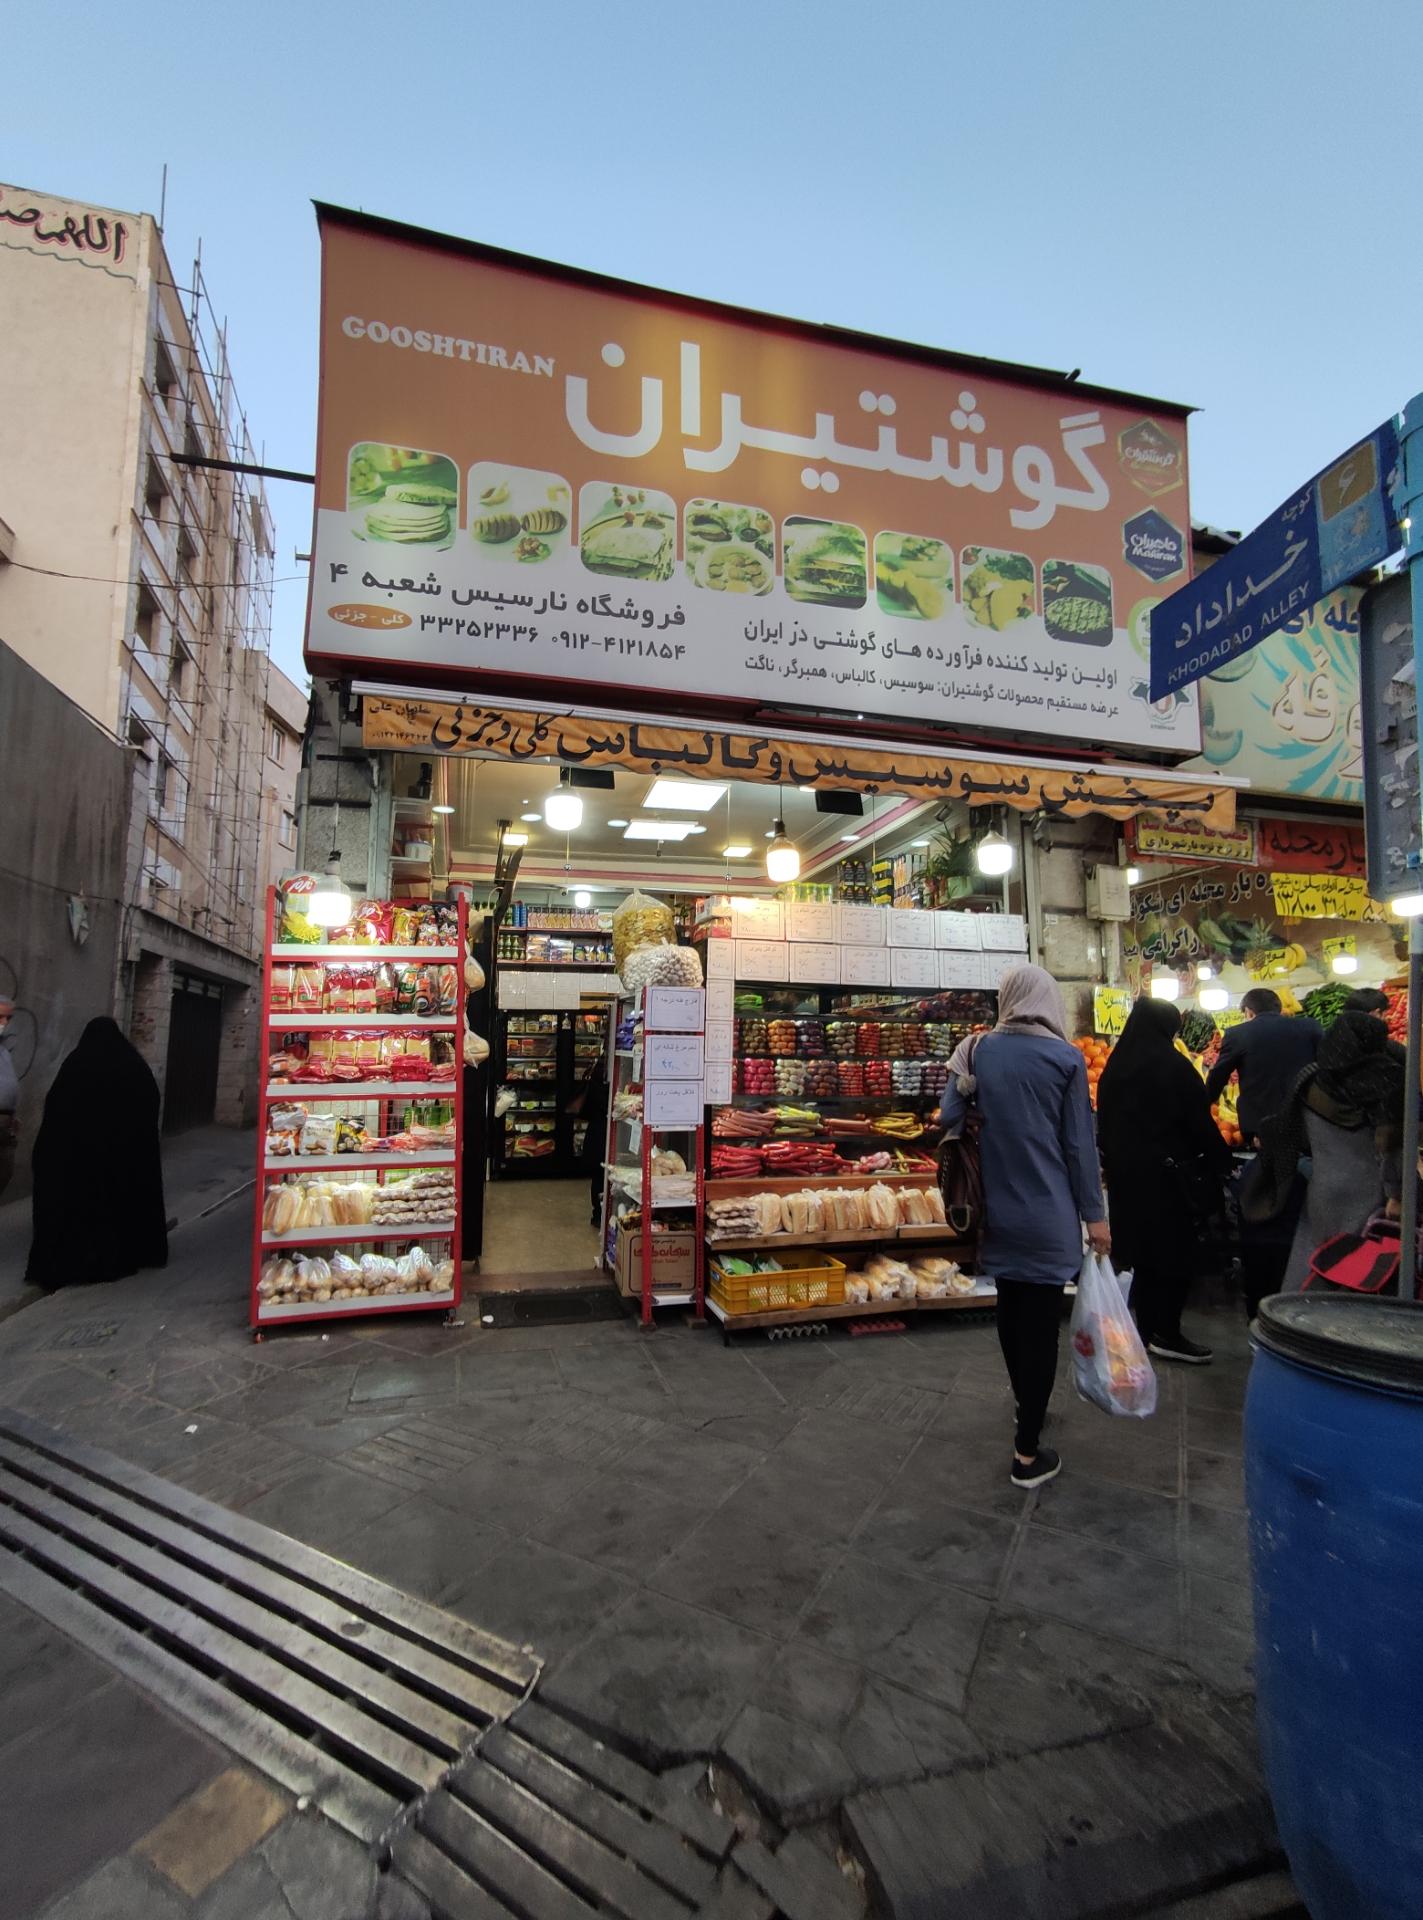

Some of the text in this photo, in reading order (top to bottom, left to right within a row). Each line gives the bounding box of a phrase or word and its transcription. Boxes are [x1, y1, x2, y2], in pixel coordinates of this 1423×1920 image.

[0, 207, 41, 224] ص
[342, 316, 556, 378] GOOSHTIRAN
[565, 341, 1110, 530] گوشتیران
[329, 562, 686, 630] فروشگاه نارسیس شعبه ۴
[1175, 529, 1309, 649] خداداد
[381, 614, 405, 626] کلی
[420, 614, 539, 643] ۳۳۲۵۲۳۳۶
[744, 619, 783, 645] ایران
[1167, 579, 1310, 685] KHODADAD ALLEY
[813, 629, 876, 655] گوشتی
[745, 654, 775, 672] ناگت
[987, 655, 1028, 672] کننده
[1033, 660, 1068, 682] تولید
[1072, 666, 1118, 689] اولین
[997, 689, 1044, 706] محصولات
[1047, 696, 1088, 712] مستقیم
[1090, 702, 1119, 718] عرضه
[509, 709, 574, 759] کلی
[557, 725, 769, 775] کالباس
[765, 751, 783, 781] و
[788, 758, 1030, 802] سوسیس
[1039, 769, 1214, 823] پخش
